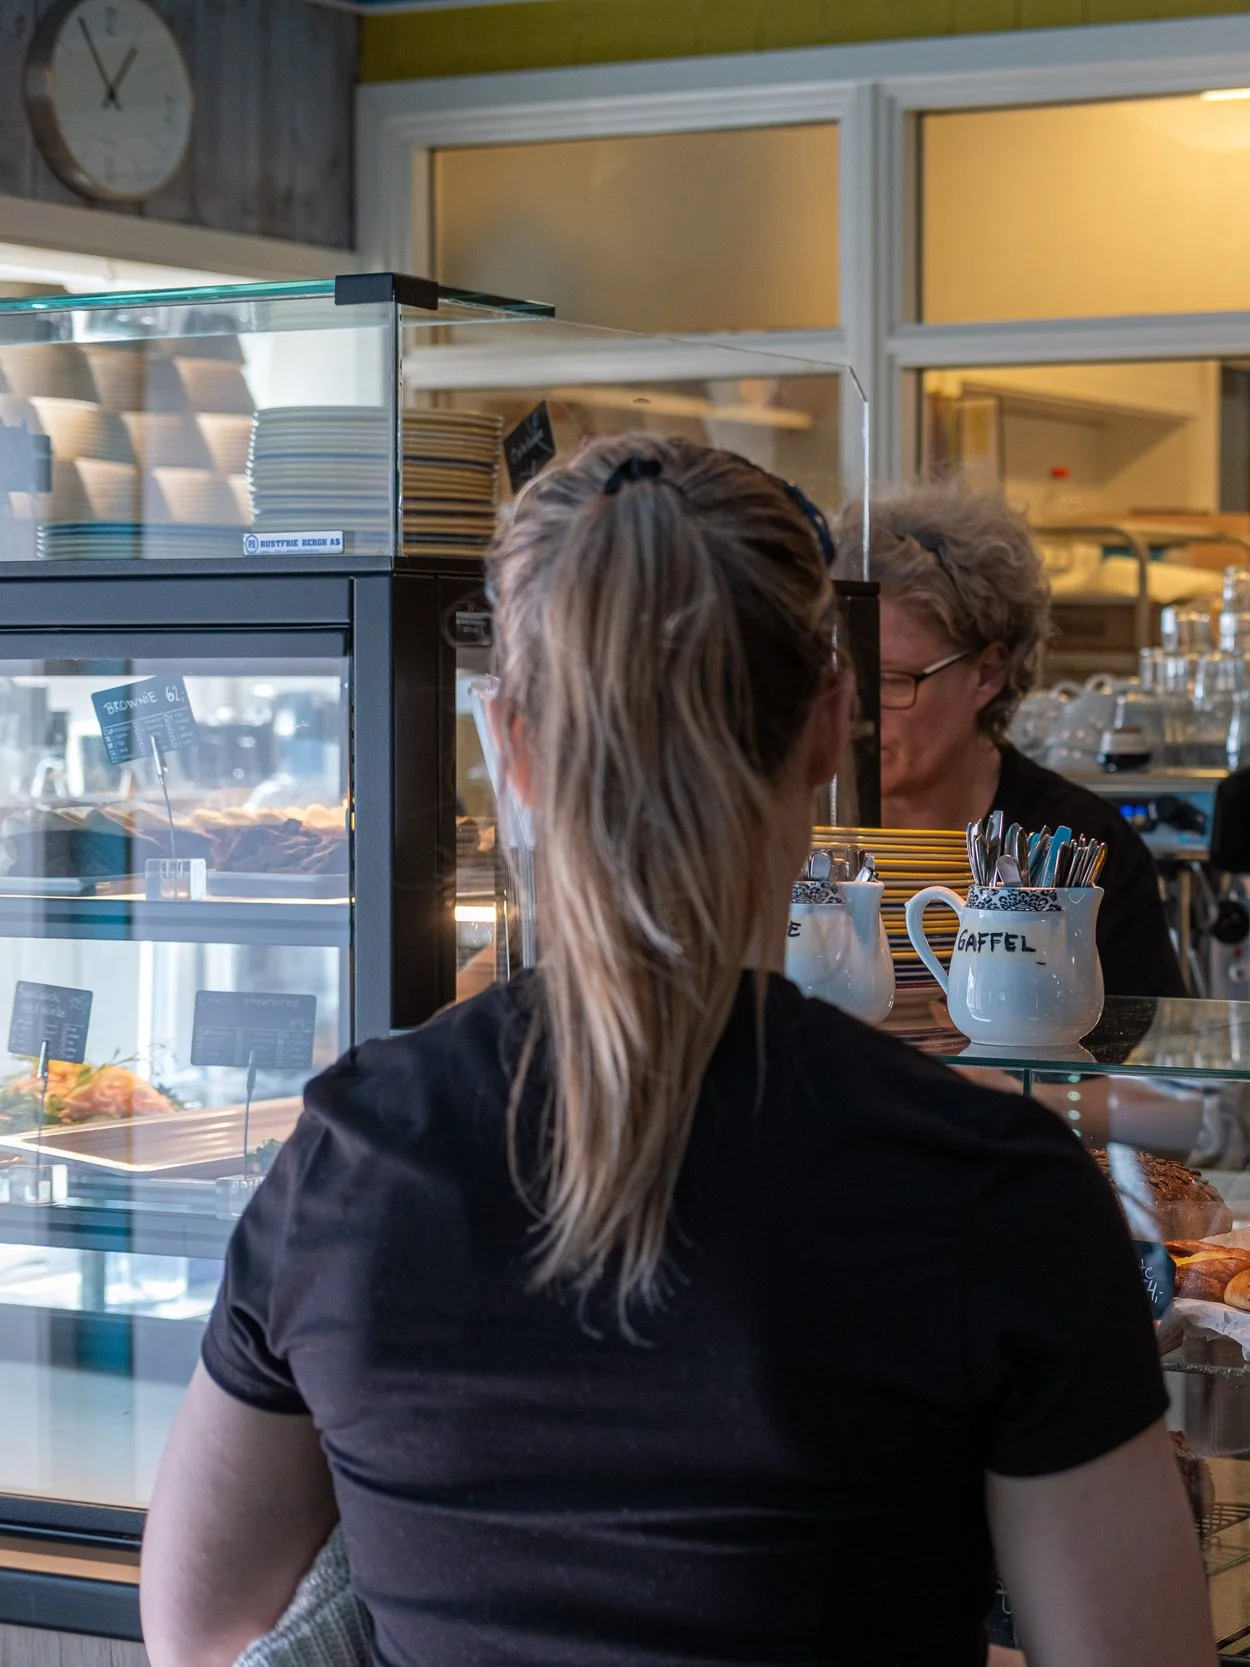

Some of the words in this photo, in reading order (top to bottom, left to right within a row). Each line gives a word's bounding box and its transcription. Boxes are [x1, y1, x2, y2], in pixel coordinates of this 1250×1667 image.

[260, 538, 299, 548] RUSTFRIE
[302, 538, 327, 547] BERGH
[330, 538, 341, 546] AS
[956, 928, 1036, 953] GAFFEL
